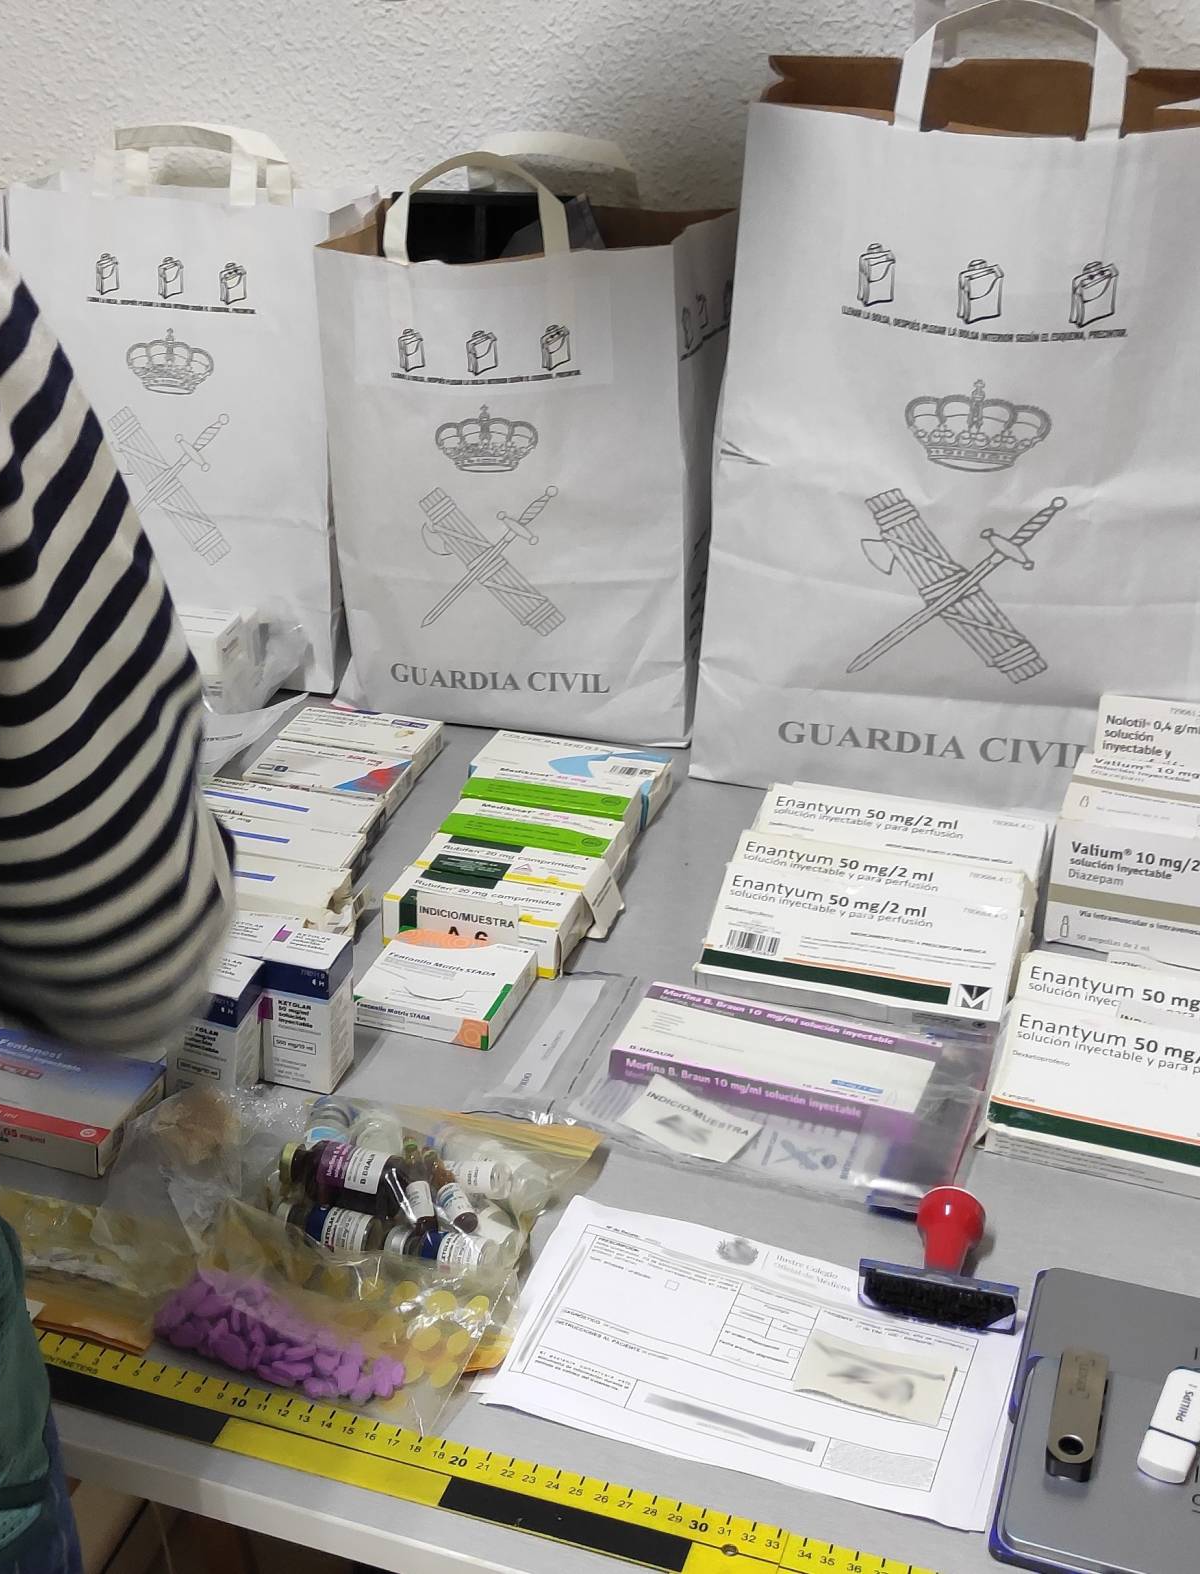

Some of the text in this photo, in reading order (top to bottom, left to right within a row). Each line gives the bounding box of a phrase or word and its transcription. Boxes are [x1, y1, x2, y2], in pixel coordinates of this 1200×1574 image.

[390, 663, 611, 694] GUARDIA CIVIL
[777, 720, 966, 760] GUARDIA
[1102, 740, 1172, 760] inyectable y
[1104, 729, 1154, 742] solución
[773, 806, 964, 840] solución inyectable y para perfusión
[775, 795, 959, 831] Enantyum 50 mg/2 ml
[499, 853, 515, 861] mg
[743, 853, 939, 893] solución inyectable y para perfusión
[745, 841, 934, 883] Enantyum 50 mg/2 ml
[1070, 857, 1173, 880] solución inyectable
[1136, 851, 1155, 865] 10
[472, 889, 488, 898] mg
[1068, 868, 1124, 886] Diazepam
[729, 887, 934, 929] solución inyectable y para perfusión
[732, 874, 927, 918] Enantyum 50 mg/2 ml
[418, 904, 516, 929] INDICIO/MUESTRA
[1028, 982, 1080, 1000] solución
[1029, 965, 1134, 999] Enantyum
[1141, 988, 1165, 1003] 50
[278, 1000, 312, 1011] KETOLAR
[662, 987, 702, 1004] Morfina
[716, 999, 746, 1014] Braun
[748, 1006, 763, 1016] 10
[766, 1010, 799, 1025] mg/ml
[800, 1017, 841, 1035] solución
[842, 1028, 895, 1046] inyectable
[1019, 1013, 1158, 1053] Enantyum 50
[1016, 1029, 1071, 1049] solución
[1074, 1040, 1143, 1064] inyectable
[1146, 1054, 1154, 1066] y
[1158, 1059, 1189, 1073] para
[626, 1057, 862, 1118] Morfina B. Braun 10 mg/ml solución inyectable
[646, 1090, 750, 1137] INDICIO/MUESTRA
[1176, 1390, 1195, 1422] PHILIPS
[132, 1369, 140, 1377] 5
[152, 1375, 161, 1383] 6
[174, 1380, 182, 1388] 7
[194, 1386, 202, 1394] 8
[216, 1391, 224, 1400] 9
[230, 1396, 248, 1408] 10
[256, 1402, 268, 1412] 11
[278, 1407, 290, 1417] 12
[298, 1413, 311, 1423] 13
[320, 1419, 333, 1430] 14
[342, 1425, 355, 1436] 15
[364, 1431, 377, 1442] 16
[386, 1437, 401, 1447] 17
[408, 1443, 422, 1453] 18
[448, 1455, 468, 1468] 20
[475, 1461, 490, 1472] 21
[500, 1468, 516, 1479] 22
[522, 1474, 536, 1485] 23
[544, 1480, 560, 1491] 24
[568, 1486, 584, 1497] 25
[594, 1492, 609, 1504] 26
[617, 1499, 634, 1510] 27
[642, 1506, 658, 1517] 28
[667, 1512, 683, 1524] 29
[688, 1519, 709, 1533] 30
[717, 1526, 733, 1537] 31
[740, 1532, 757, 1544] 32
[764, 1538, 780, 1550] 33
[797, 1549, 812, 1560] 34
[820, 1555, 835, 1567] 35
[846, 1562, 862, 1574] 36
